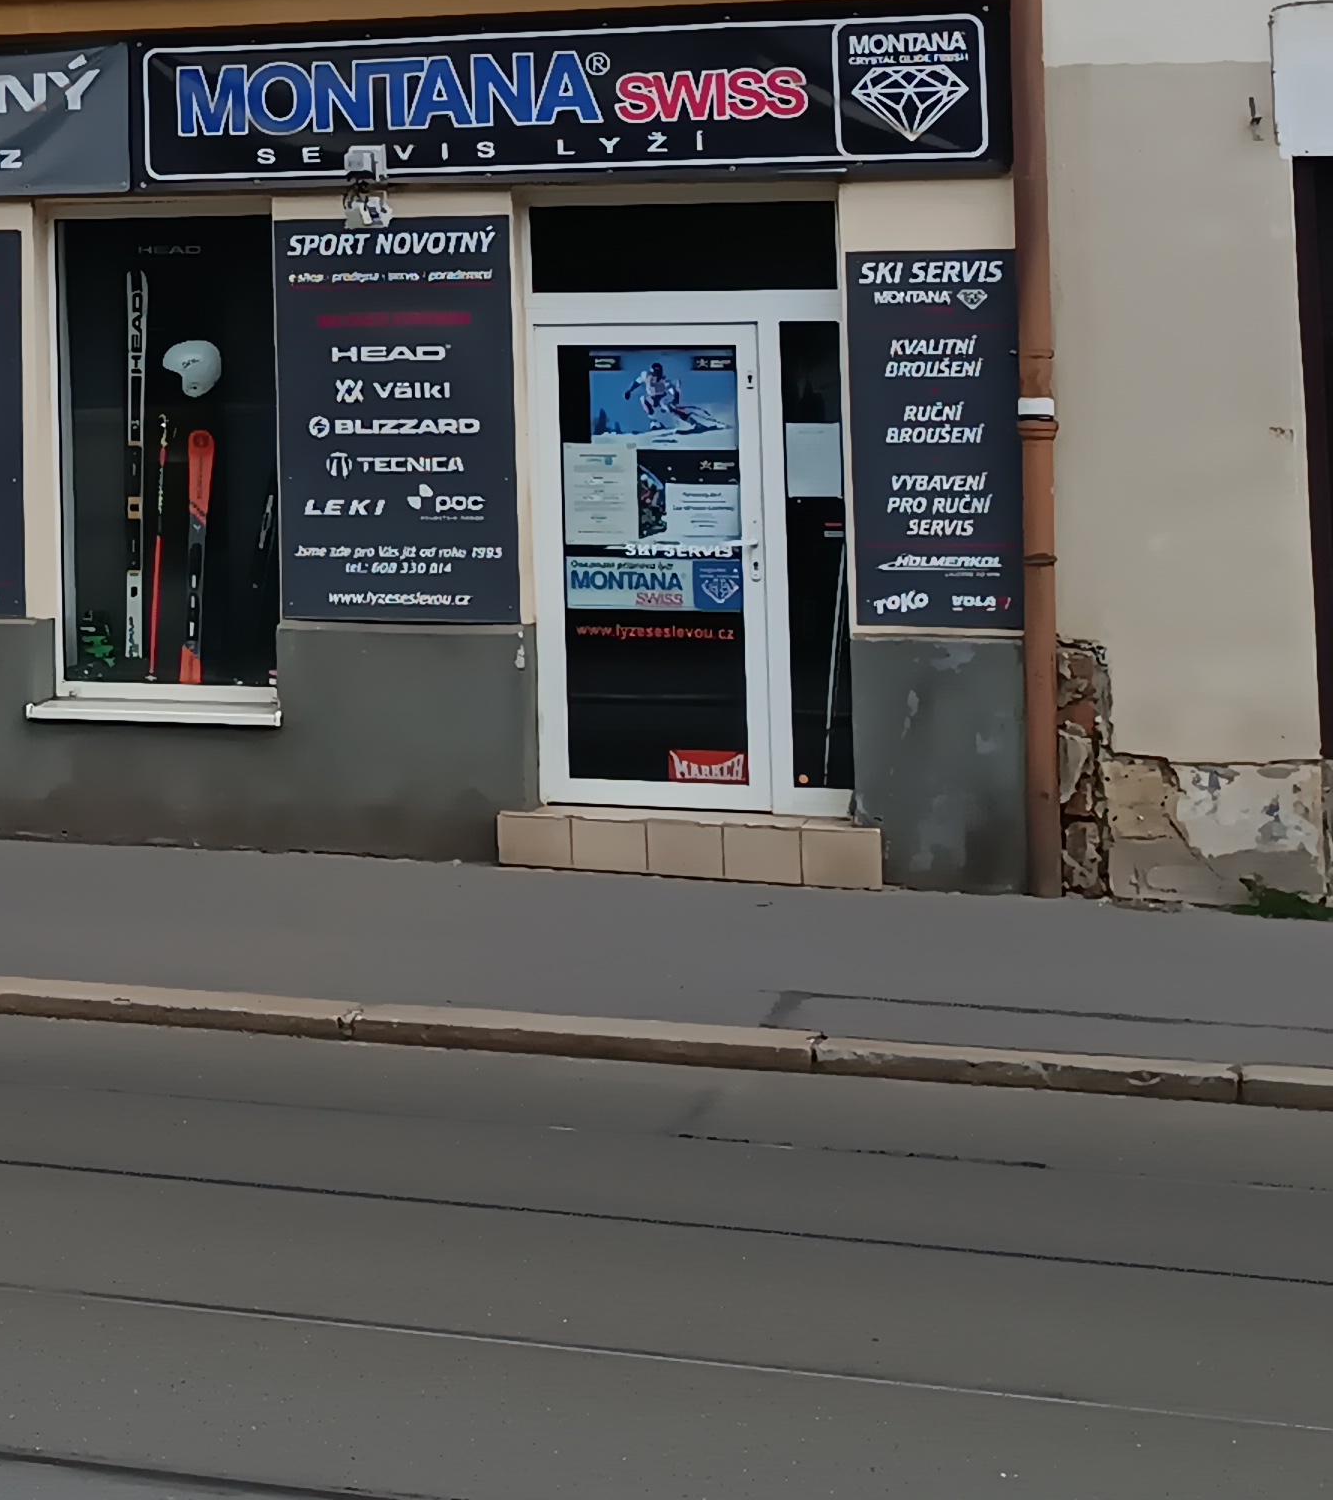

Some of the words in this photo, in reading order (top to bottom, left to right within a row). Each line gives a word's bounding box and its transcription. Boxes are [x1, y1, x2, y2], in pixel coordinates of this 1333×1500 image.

[849, 31, 967, 54] MONTANA
[614, 67, 808, 123] SWISS
[257, 141, 495, 165] SEVIS
[557, 130, 703, 156] LYŽÍ
[287, 233, 370, 256] SPORT
[376, 225, 496, 255] NOVOTNÝ
[858, 262, 903, 284] SKI
[909, 261, 1003, 283] SERVIS
[331, 346, 446, 362] HEAD
[890, 334, 978, 357] KVALITNÍ
[885, 357, 984, 377] BROUŠENÍ
[373, 382, 451, 398] Völkl
[904, 401, 965, 421] RUČNÍ
[334, 418, 481, 434] BLIZZARD
[885, 423, 985, 443] BROUŠENÍ
[356, 457, 464, 473] TECNICA
[891, 472, 988, 491] VYBAVENÍ
[304, 499, 386, 516] LEKI
[887, 496, 927, 514] PRO
[933, 494, 993, 514] RUČNÍ
[906, 519, 974, 537] SERVIS
[571, 570, 684, 591] MONTANA
